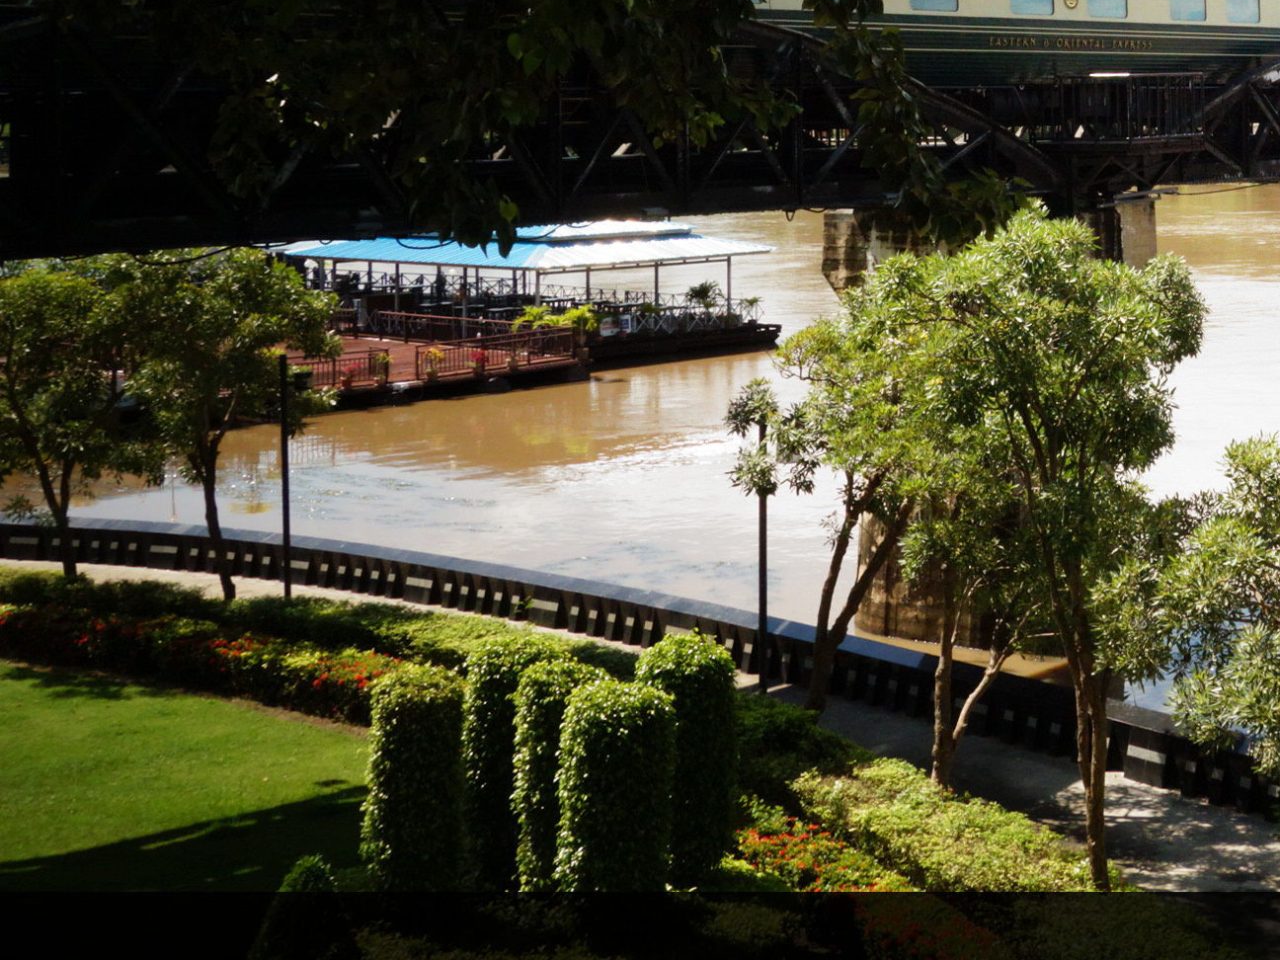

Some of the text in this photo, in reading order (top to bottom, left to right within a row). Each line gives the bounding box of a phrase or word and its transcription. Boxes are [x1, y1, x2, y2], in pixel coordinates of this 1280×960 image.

[989, 36, 1037, 48] EASTERN
[1056, 37, 1105, 50] ORIENTAL
[1112, 38, 1153, 51] EXPRESS
